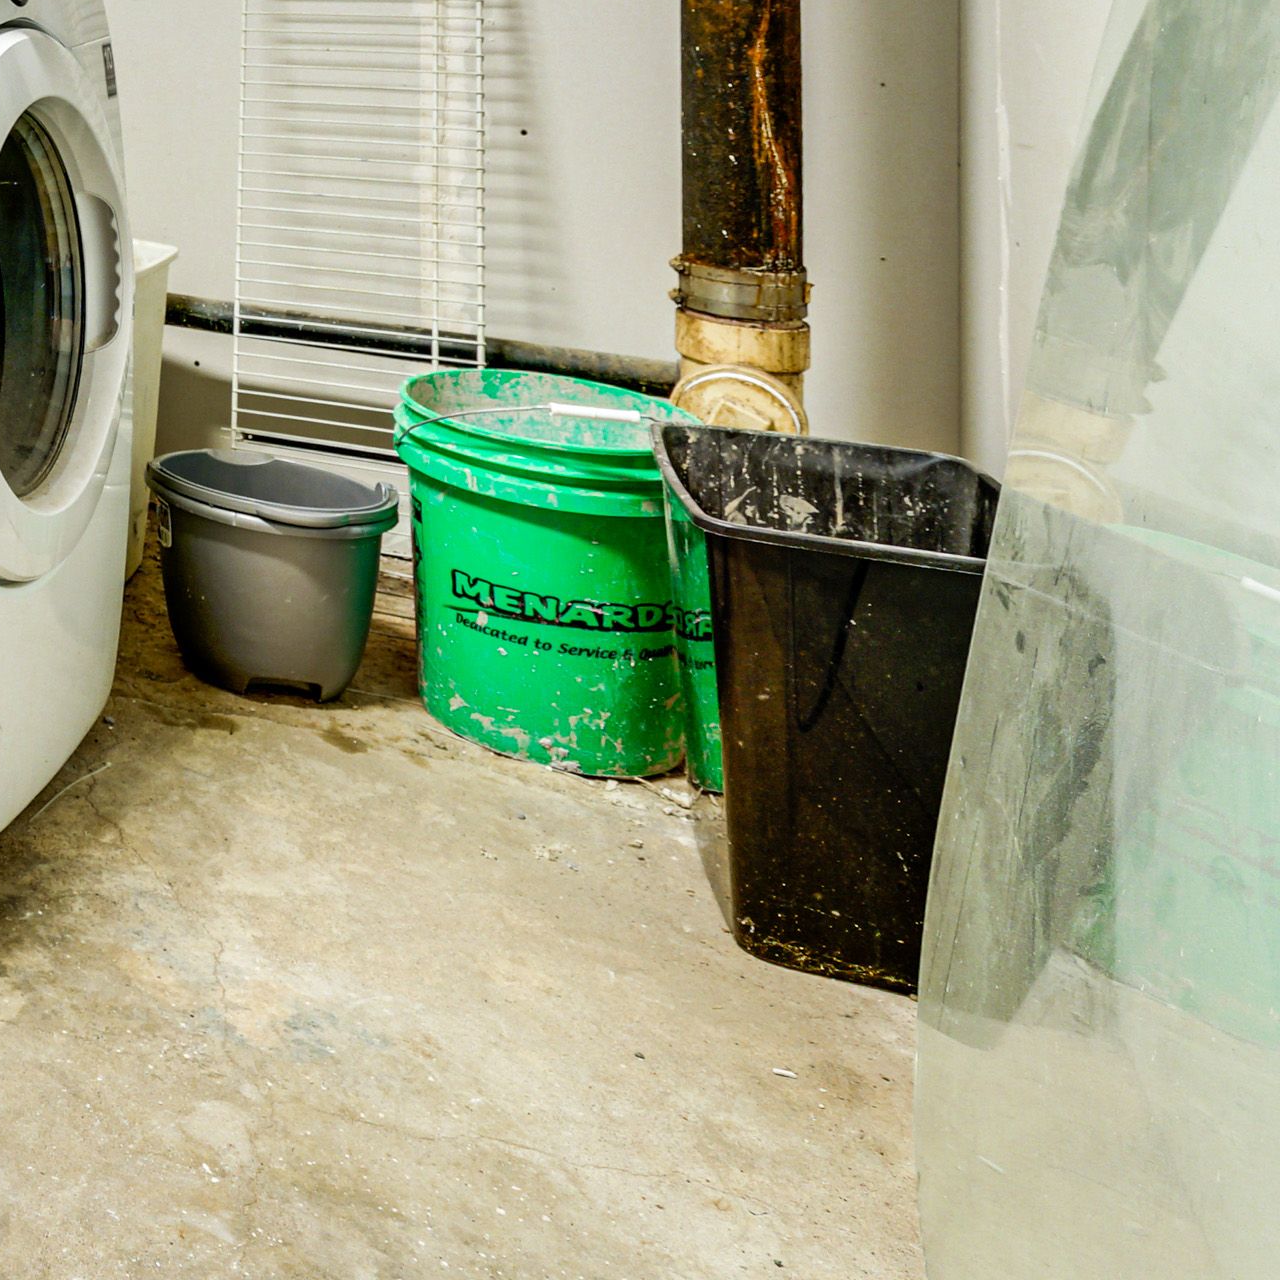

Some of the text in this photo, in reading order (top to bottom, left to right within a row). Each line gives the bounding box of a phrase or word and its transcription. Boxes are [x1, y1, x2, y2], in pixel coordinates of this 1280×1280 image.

[455, 612, 529, 646] Dedicated
[534, 638, 552, 652] to
[558, 643, 618, 660] Service
